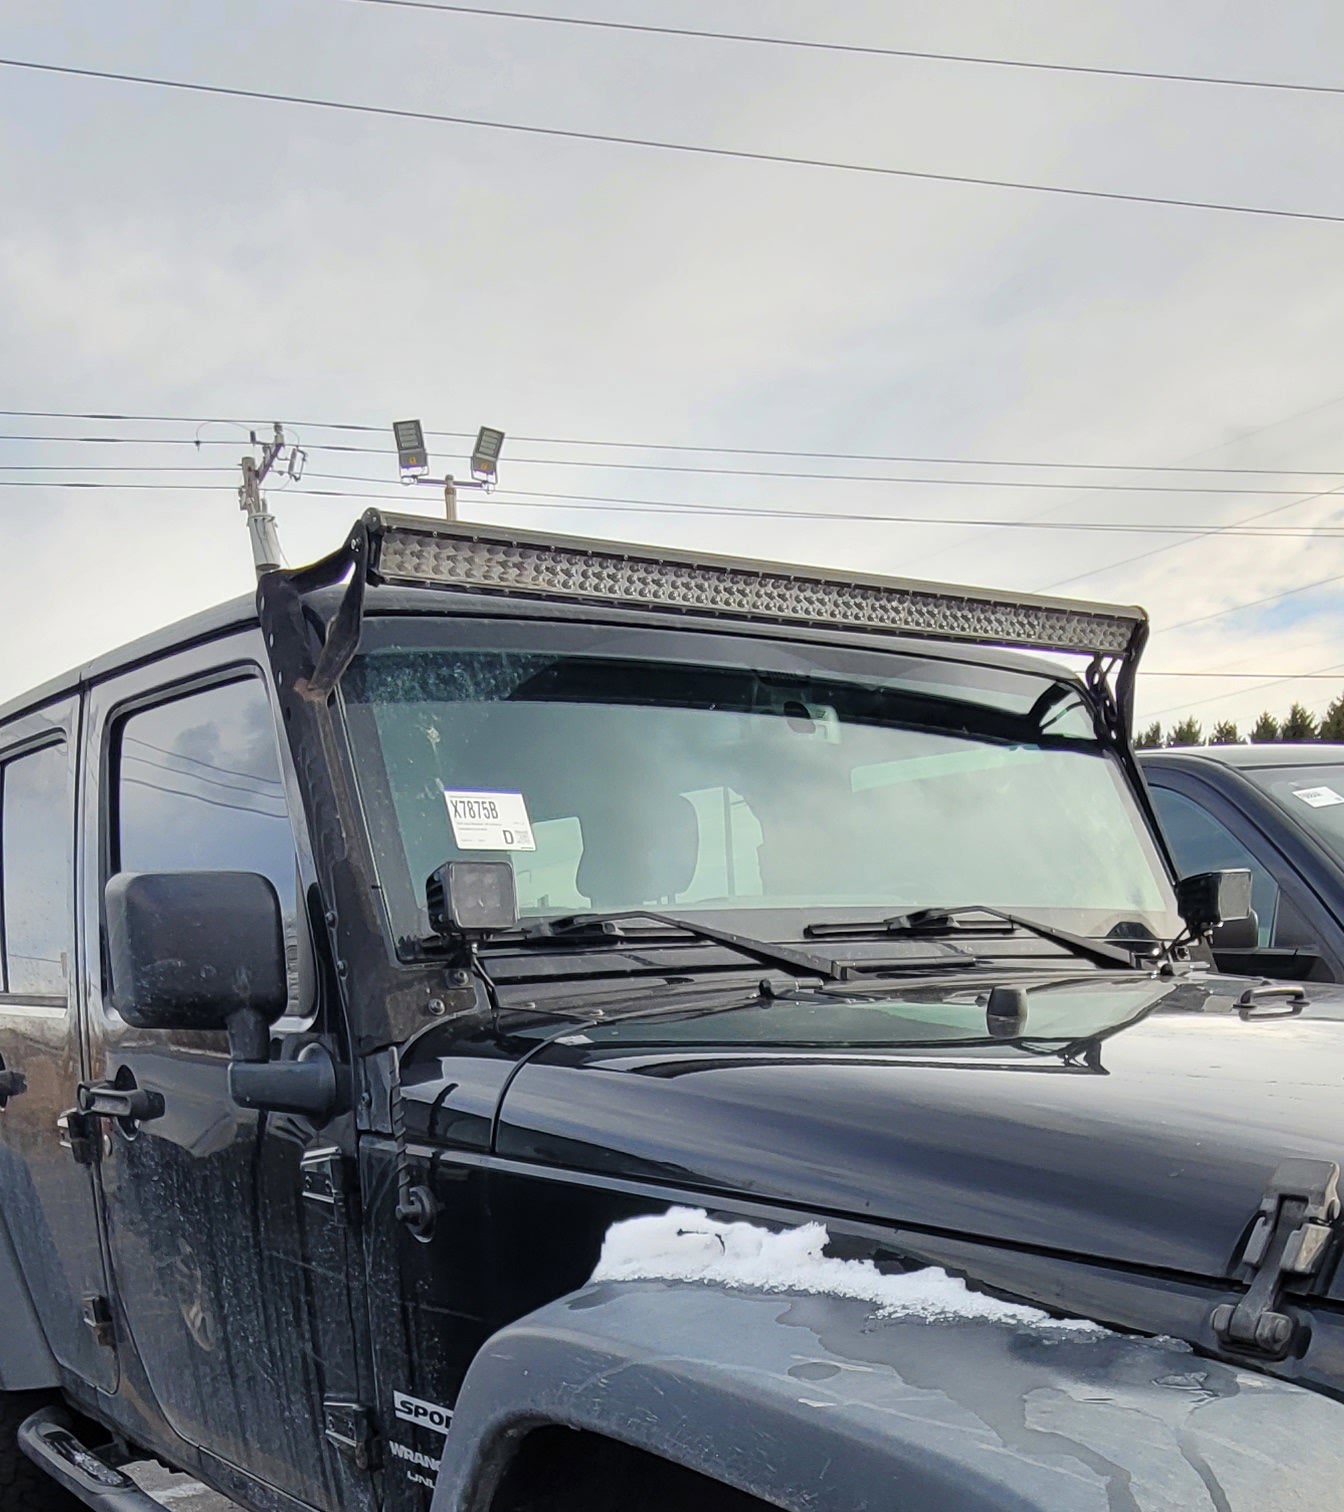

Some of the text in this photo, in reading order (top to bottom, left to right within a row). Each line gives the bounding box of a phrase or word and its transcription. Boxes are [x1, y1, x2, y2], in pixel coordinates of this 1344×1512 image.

[450, 799, 499, 819] X7875B
[502, 829, 515, 845] D
[388, 1439, 441, 1472] WRAN
